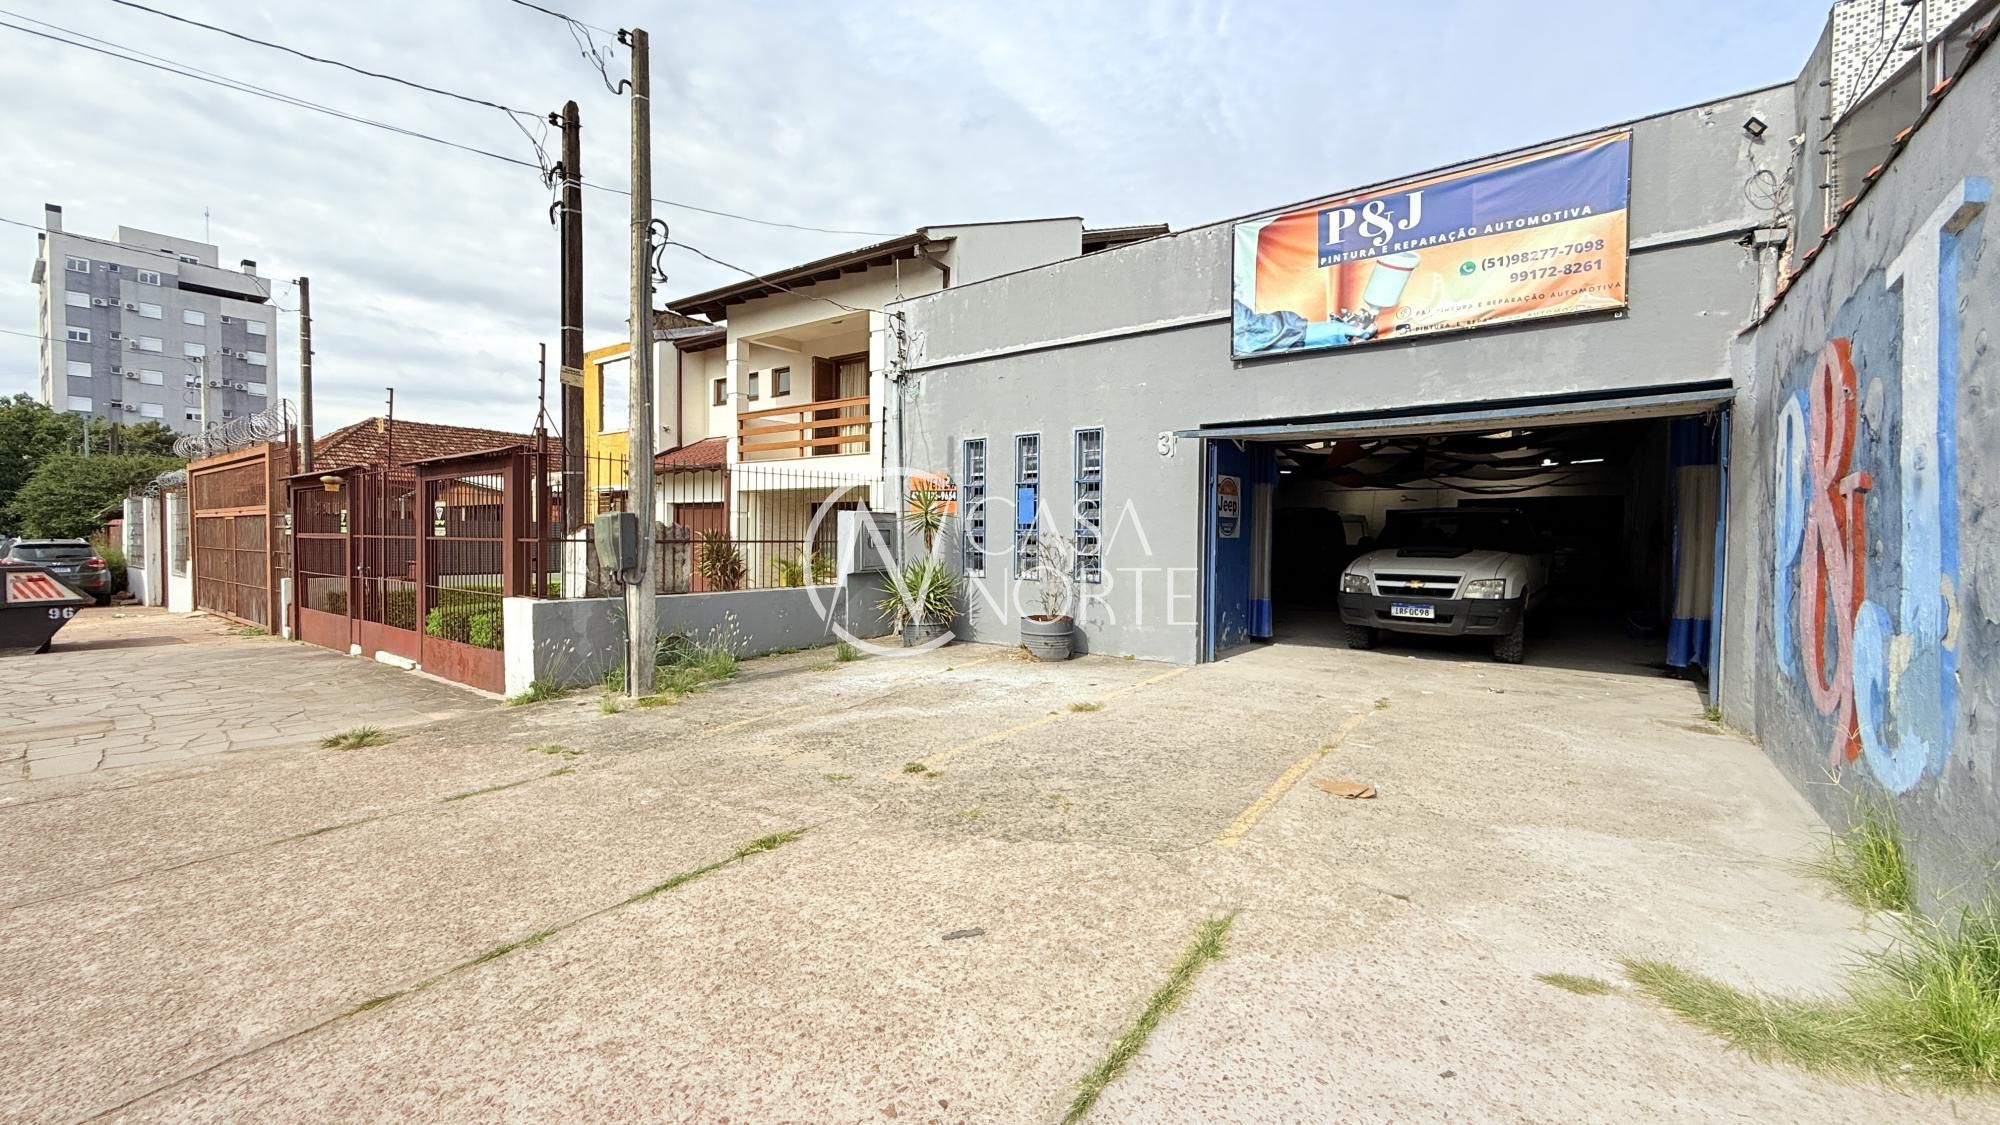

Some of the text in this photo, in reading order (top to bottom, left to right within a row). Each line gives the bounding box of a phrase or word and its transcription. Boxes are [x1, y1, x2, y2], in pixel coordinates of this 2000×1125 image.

[1326, 190, 1424, 247] P&J
[1320, 205, 1592, 266] PINTURA E REPARAÇÃO AUTOMOTIVA
[1481, 239, 1605, 272] (51)98277-7098
[1509, 259, 1602, 283] 99172-8261
[1487, 293, 1545, 306] REPARAÇÃO
[1550, 282, 1622, 298] AUTOMOTIVA
[1218, 496, 1237, 516] Jeep
[48, 607, 75, 619] 96
